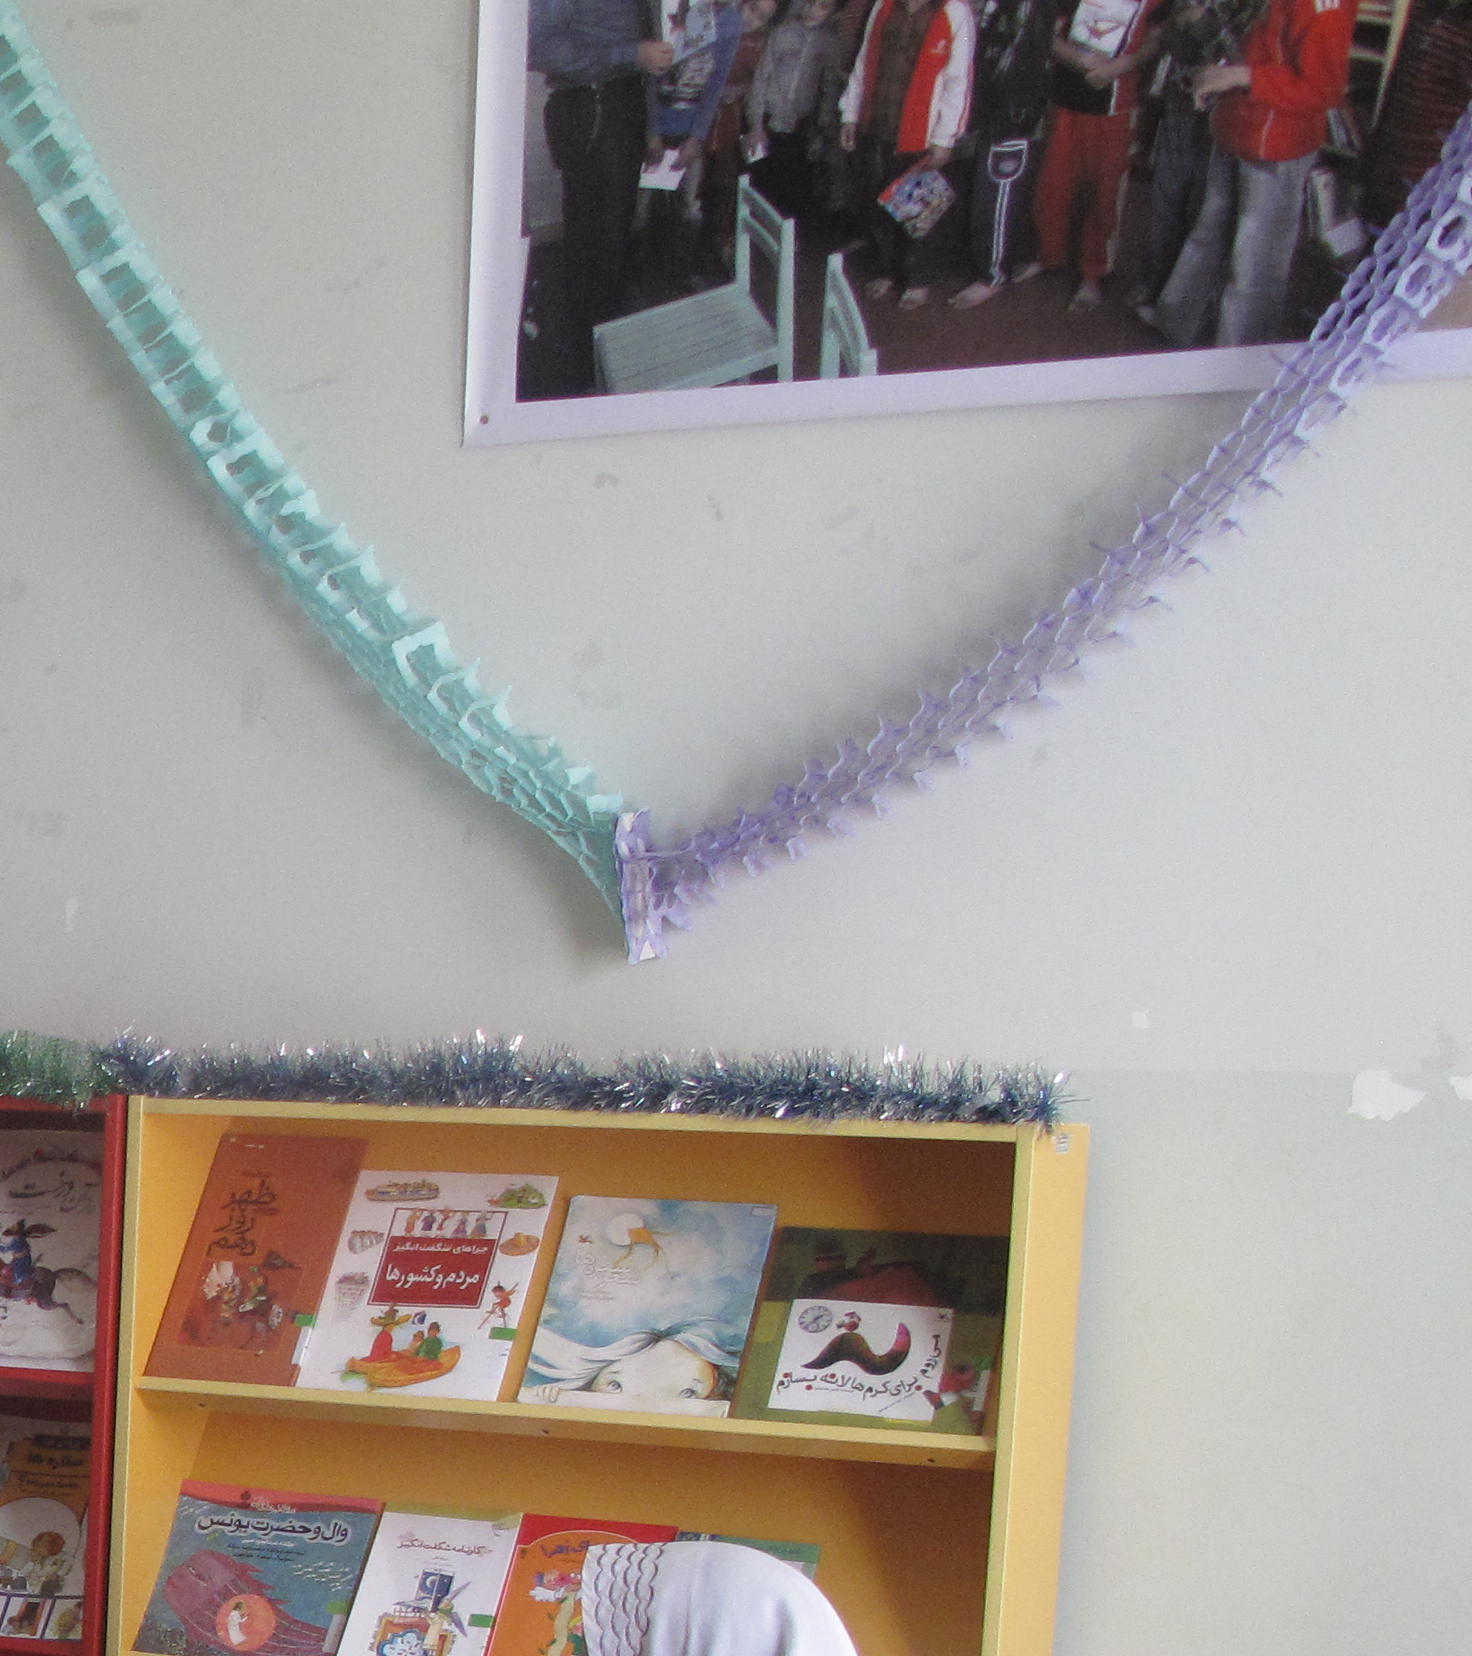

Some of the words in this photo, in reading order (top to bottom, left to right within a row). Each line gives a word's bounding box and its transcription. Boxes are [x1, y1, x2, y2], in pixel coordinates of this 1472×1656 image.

[213, 1208, 255, 1235] روز
[205, 1235, 256, 1257] دهم
[385, 1263, 442, 1289] کشورها
[432, 1273, 443, 1290] و
[441, 1270, 480, 1290] مردم
[776, 1371, 818, 1395] بسازم
[820, 1371, 851, 1388] لانه
[888, 1376, 923, 1397] برای
[862, 1382, 889, 1401] کرم
[196, 1512, 251, 1535] یونس
[250, 1519, 313, 1537] حضرت
[308, 1524, 322, 1541] و
[320, 1520, 350, 1543] وال
[396, 1538, 424, 1550] انگیز
[423, 1541, 452, 1552] شگفت
